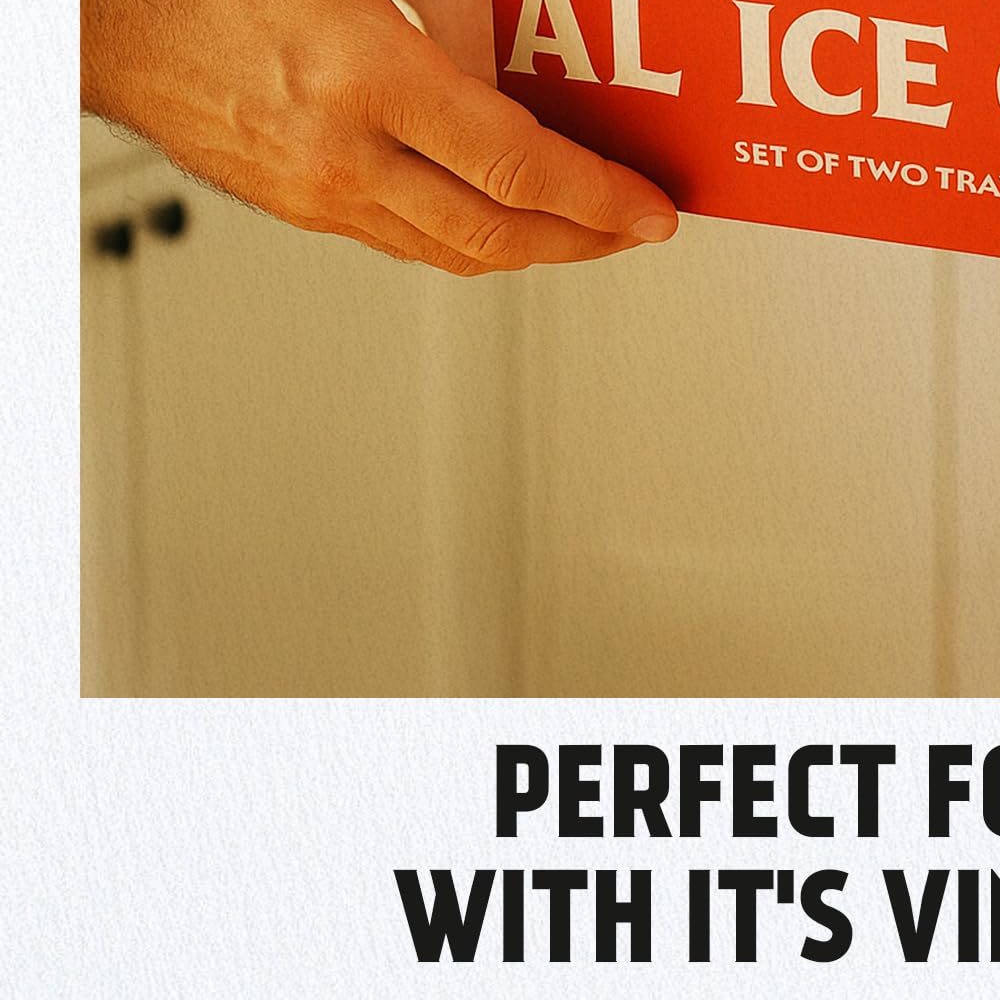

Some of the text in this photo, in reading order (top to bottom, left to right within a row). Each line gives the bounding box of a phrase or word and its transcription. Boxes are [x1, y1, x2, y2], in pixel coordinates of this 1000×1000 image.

[733, 0, 953, 129] ICE
[734, 140, 788, 169] SET
[795, 149, 842, 176] OF
[847, 155, 928, 187] TWO
